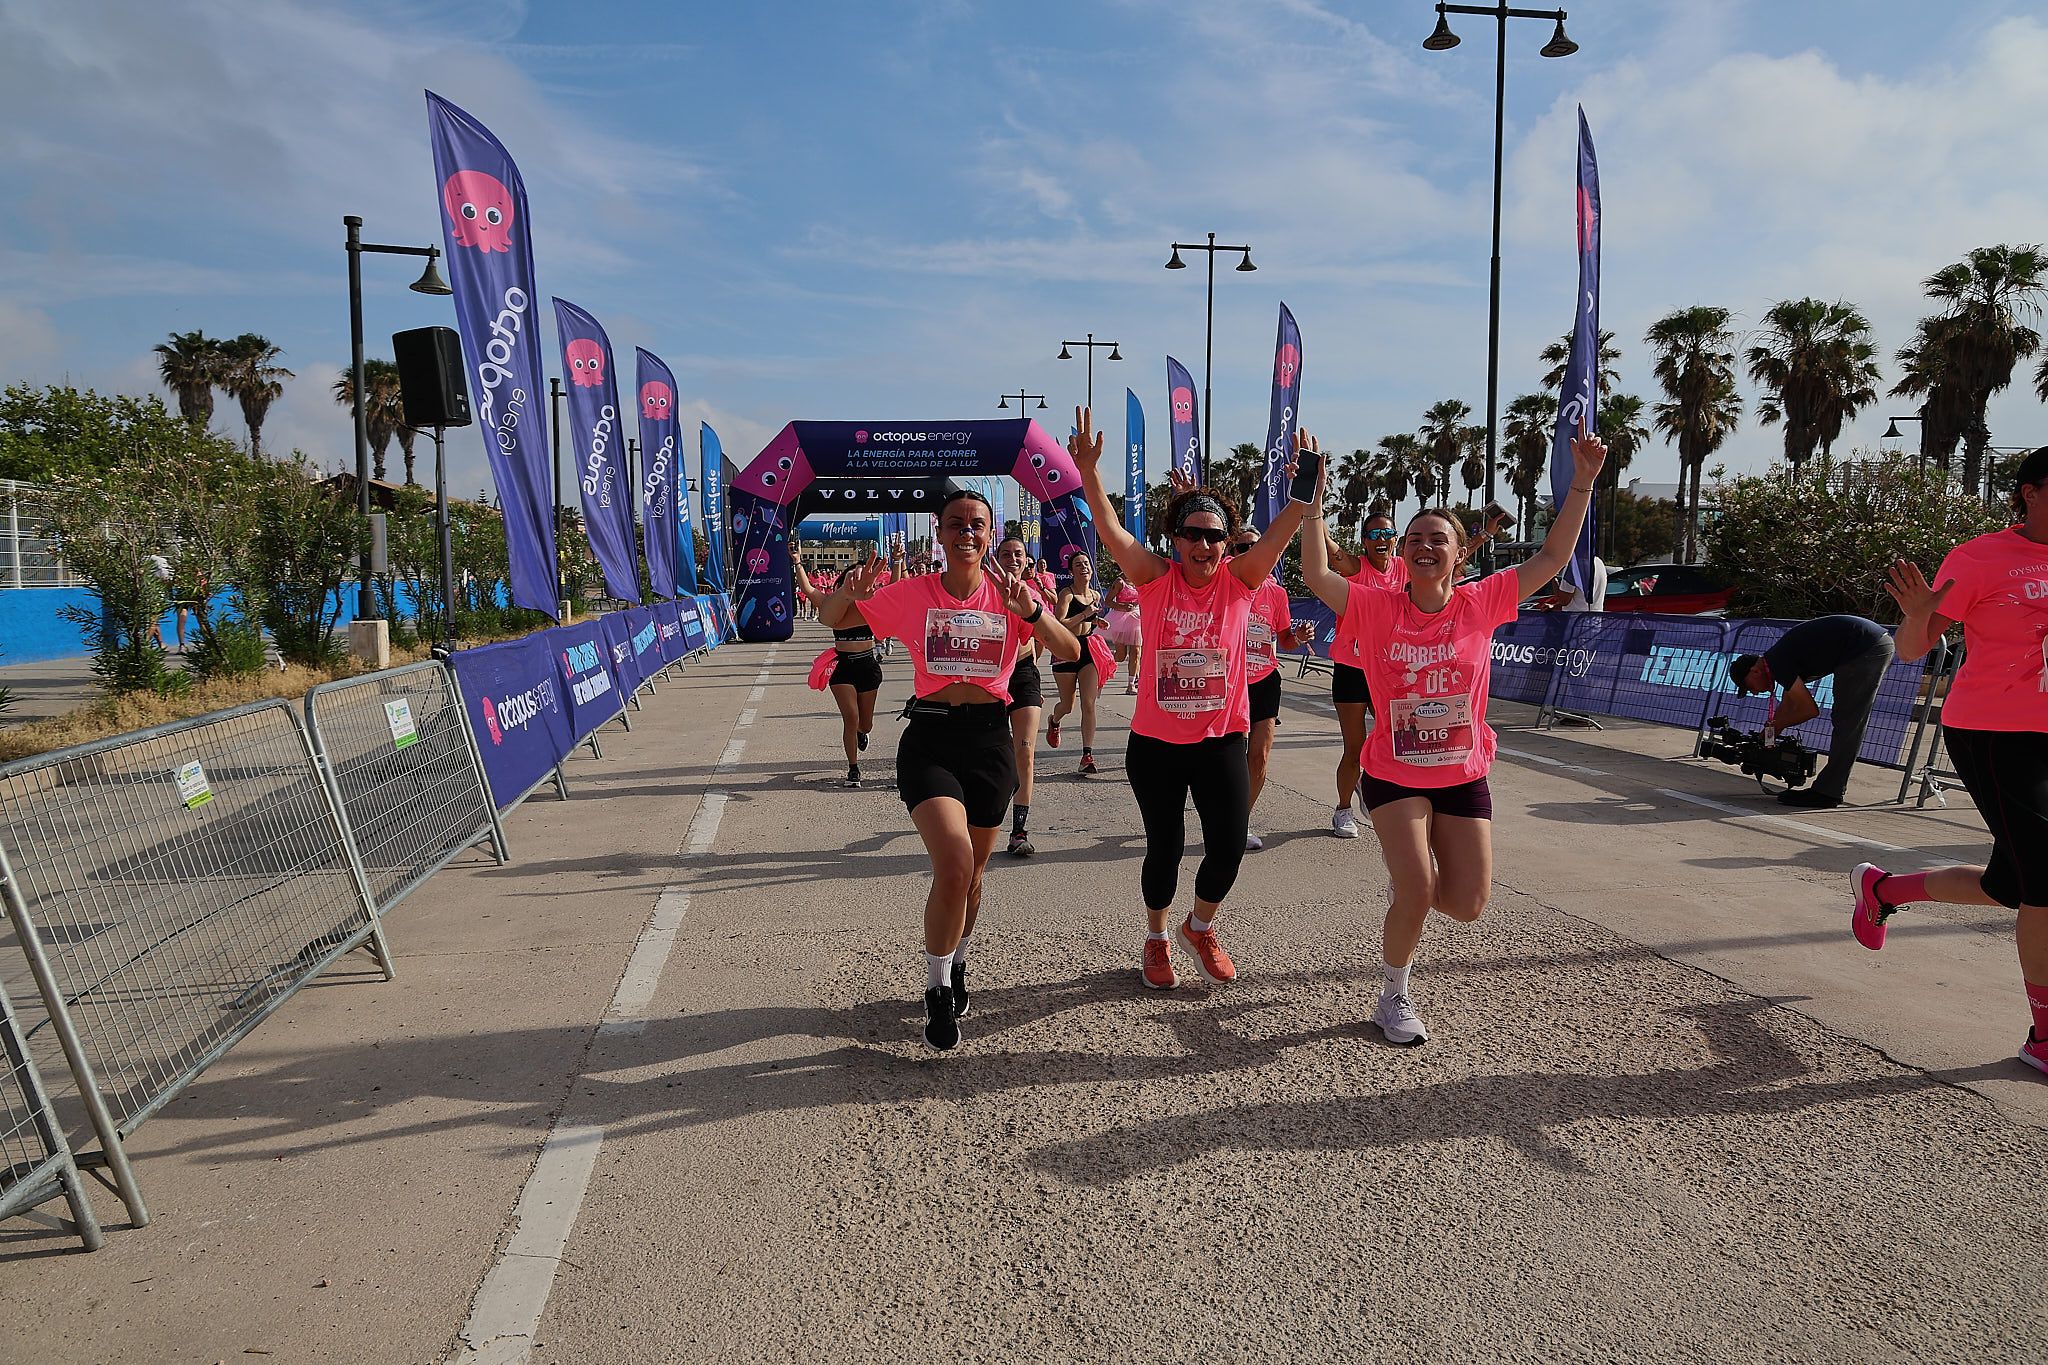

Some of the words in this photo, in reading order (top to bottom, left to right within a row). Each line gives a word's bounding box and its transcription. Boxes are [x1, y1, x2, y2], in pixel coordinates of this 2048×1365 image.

[873, 431, 927, 444] octopus
[927, 432, 972, 445] energy
[847, 449, 861, 458] LA
[862, 448, 906, 458] ENERGÍA
[908, 450, 935, 458] PARA
[937, 449, 977, 458] CORRER
[846, 460, 854, 468] A
[856, 460, 869, 468] LA
[871, 460, 928, 468] VELOCIDAD
[929, 460, 943, 468] DE
[944, 460, 957, 468] LA
[819, 489, 925, 499] VOLVO
[2008, 563, 2048, 577] OYSHO
[950, 637, 980, 650] 016
[1247, 640, 1262, 648] 016
[1390, 641, 1457, 665] CARRERA
[1491, 638, 1535, 667] topus
[1535, 646, 1597, 678] energy
[1179, 677, 1206, 689] 016
[1426, 668, 1449, 694] DE
[1418, 728, 1449, 742] 016
